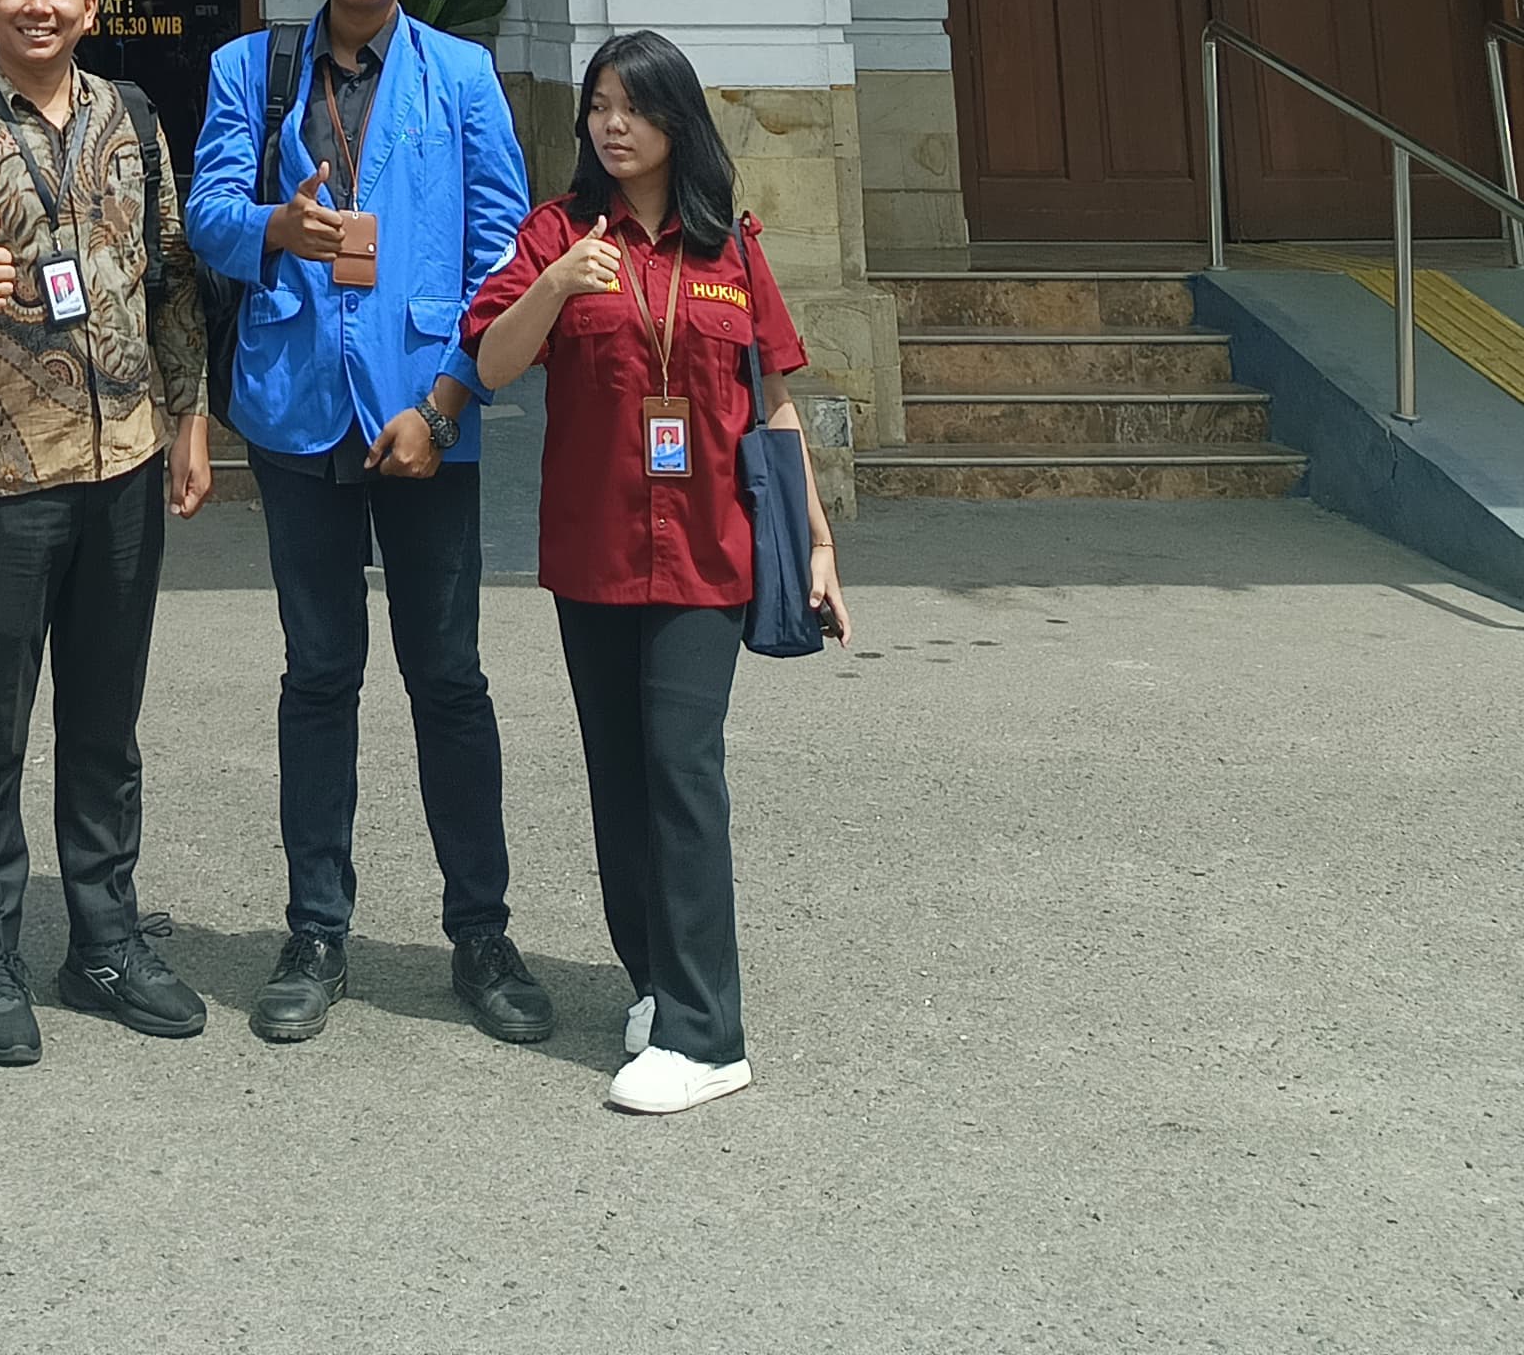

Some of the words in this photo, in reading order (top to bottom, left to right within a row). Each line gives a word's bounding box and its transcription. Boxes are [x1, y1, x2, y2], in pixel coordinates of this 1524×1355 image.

[106, 17, 148, 36] 15.30
[152, 17, 183, 35] WIB
[693, 282, 747, 308] HUKUM
